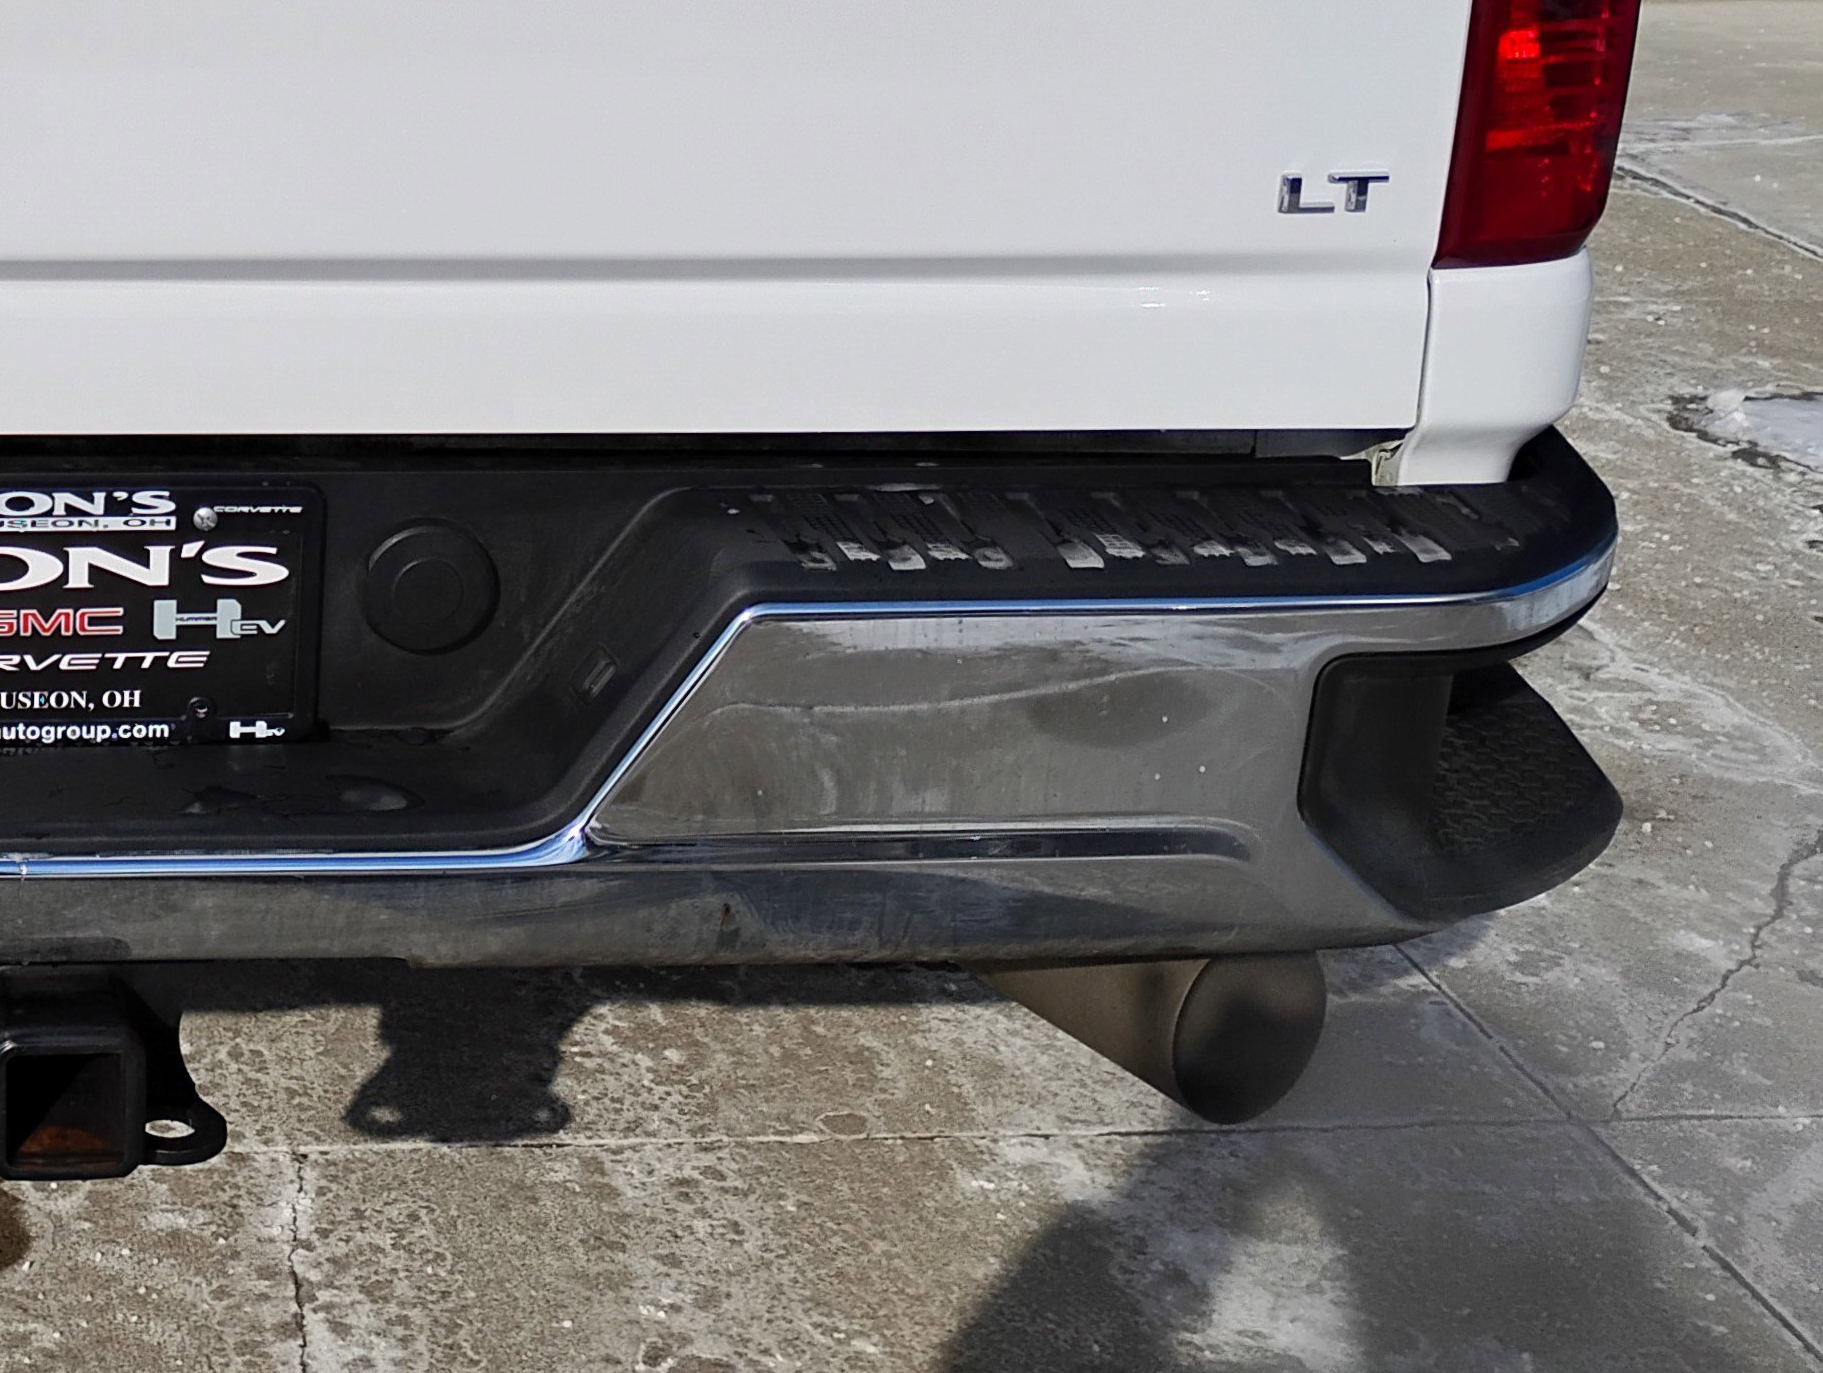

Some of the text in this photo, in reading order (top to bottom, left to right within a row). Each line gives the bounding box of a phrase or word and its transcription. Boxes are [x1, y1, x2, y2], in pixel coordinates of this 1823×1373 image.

[1277, 170, 1390, 214] LT
[212, 505, 303, 514] CORVETTE
[122, 518, 172, 527] OH
[102, 690, 142, 708] OH
